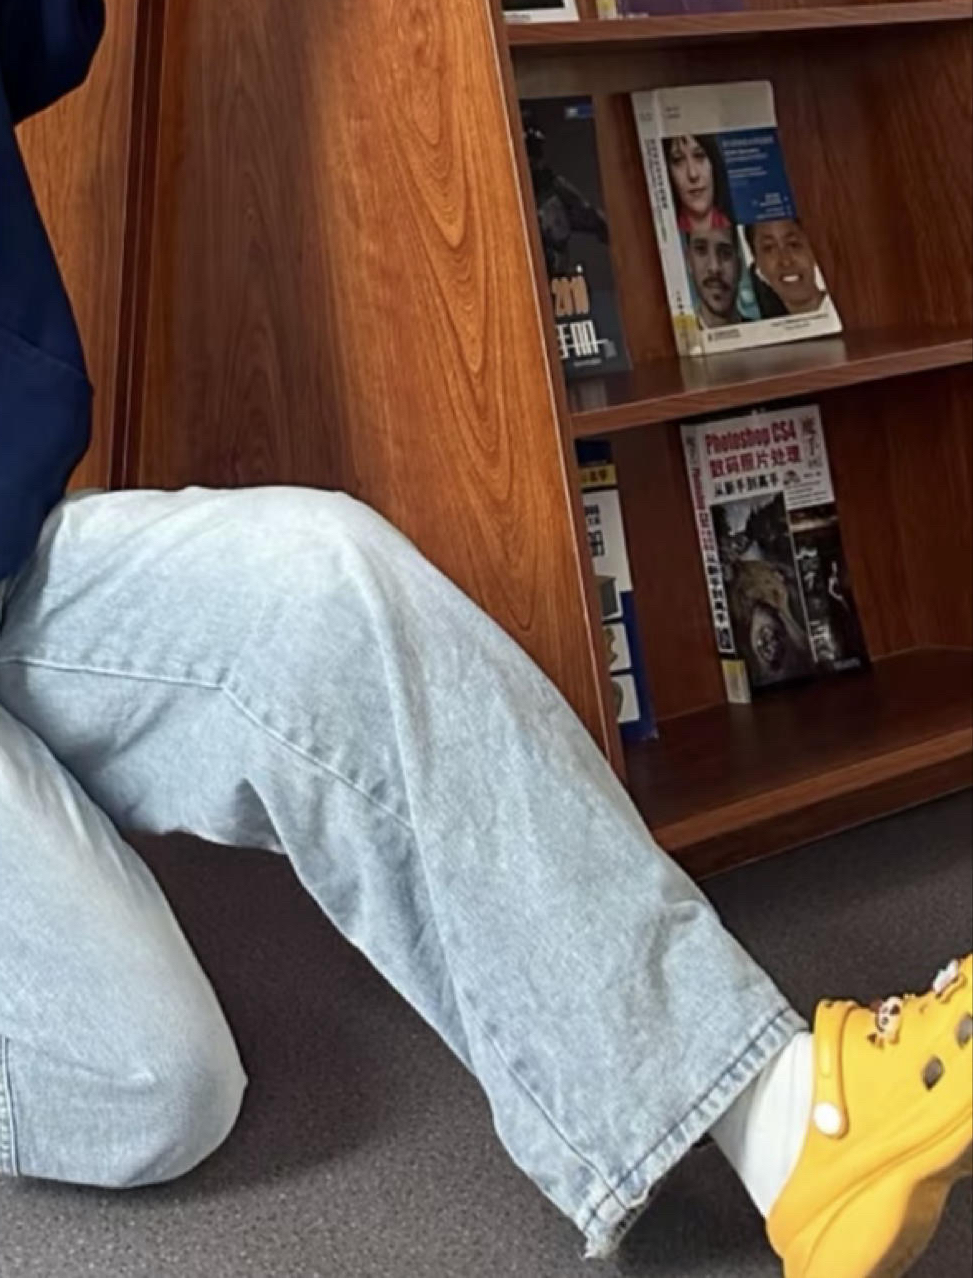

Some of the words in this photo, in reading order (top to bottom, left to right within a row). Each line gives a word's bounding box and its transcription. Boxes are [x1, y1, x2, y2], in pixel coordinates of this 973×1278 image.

[706, 427, 771, 455] Photoshop
[771, 420, 797, 443] CS4
[709, 445, 801, 479] 数码照片处理
